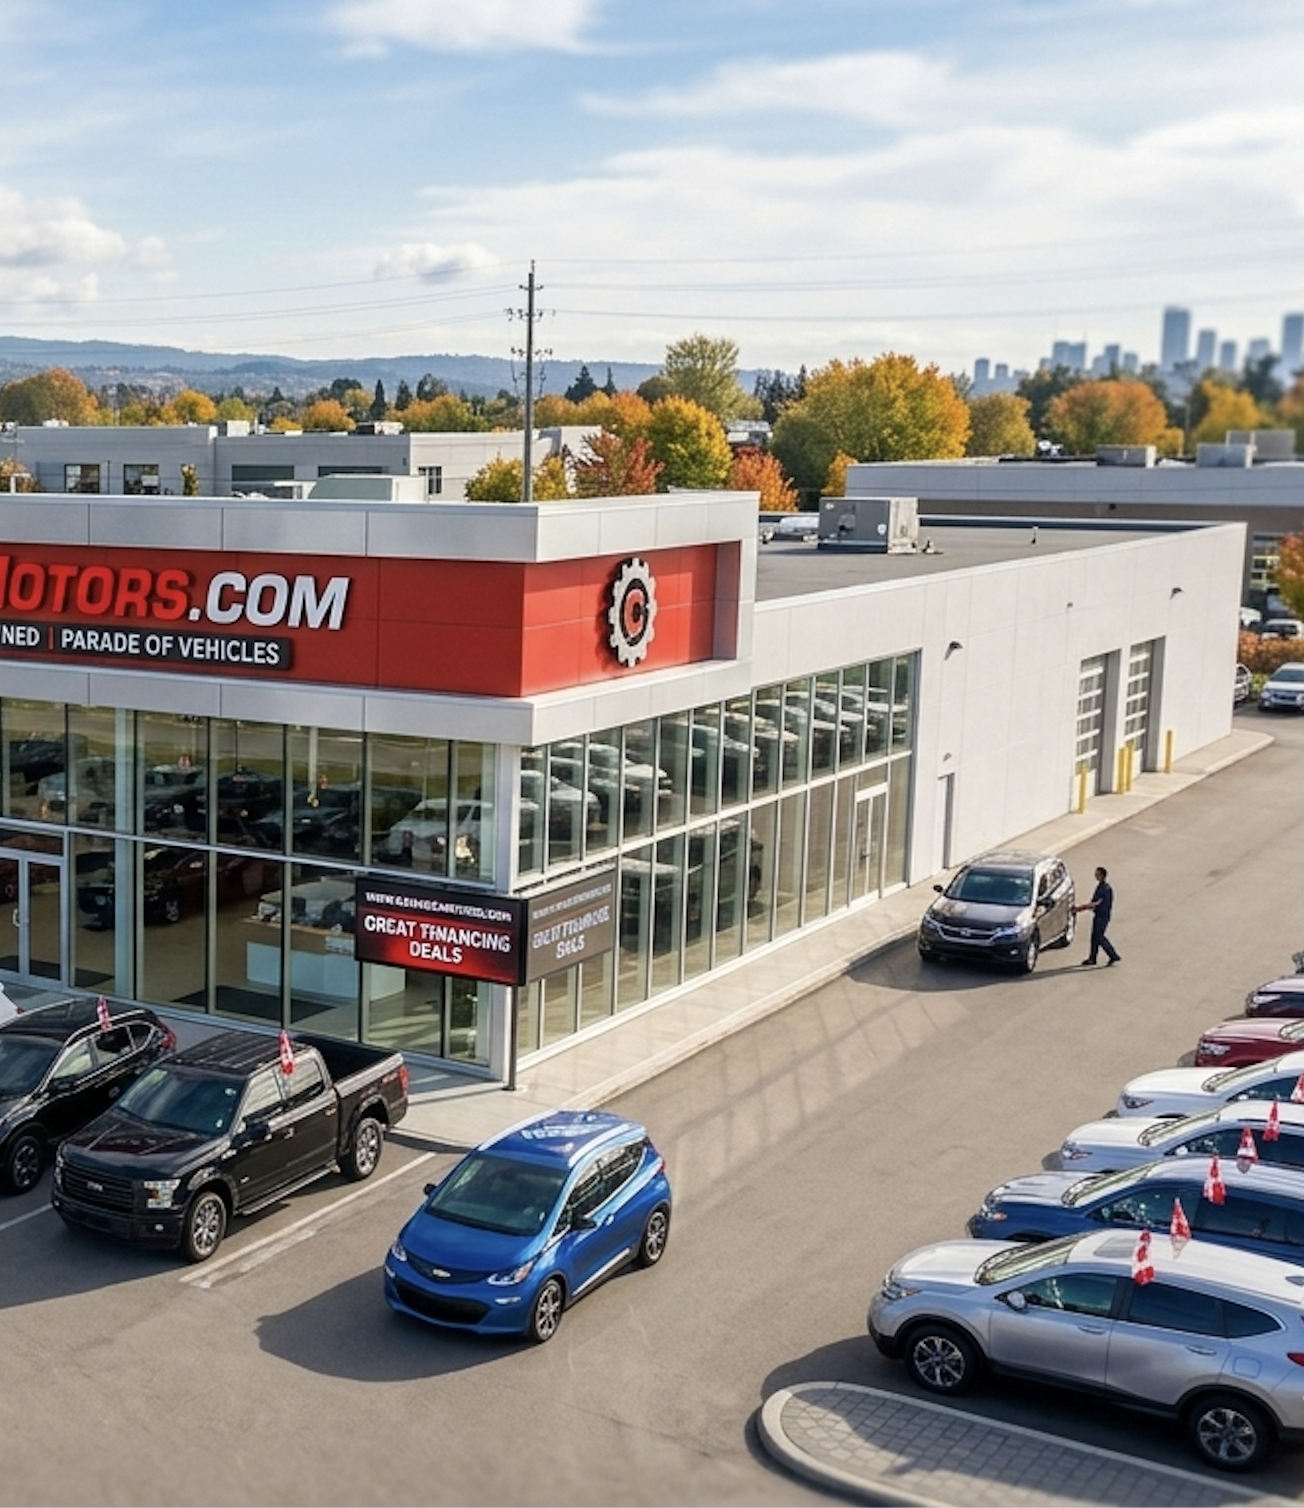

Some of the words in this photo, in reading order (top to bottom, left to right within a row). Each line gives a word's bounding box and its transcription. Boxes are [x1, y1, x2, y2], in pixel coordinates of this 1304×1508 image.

[60, 628, 141, 655] PARADE
[145, 634, 174, 656] OF
[177, 636, 280, 665] VEHICLES
[364, 914, 417, 937] GREAT
[409, 940, 463, 964] DEALS
